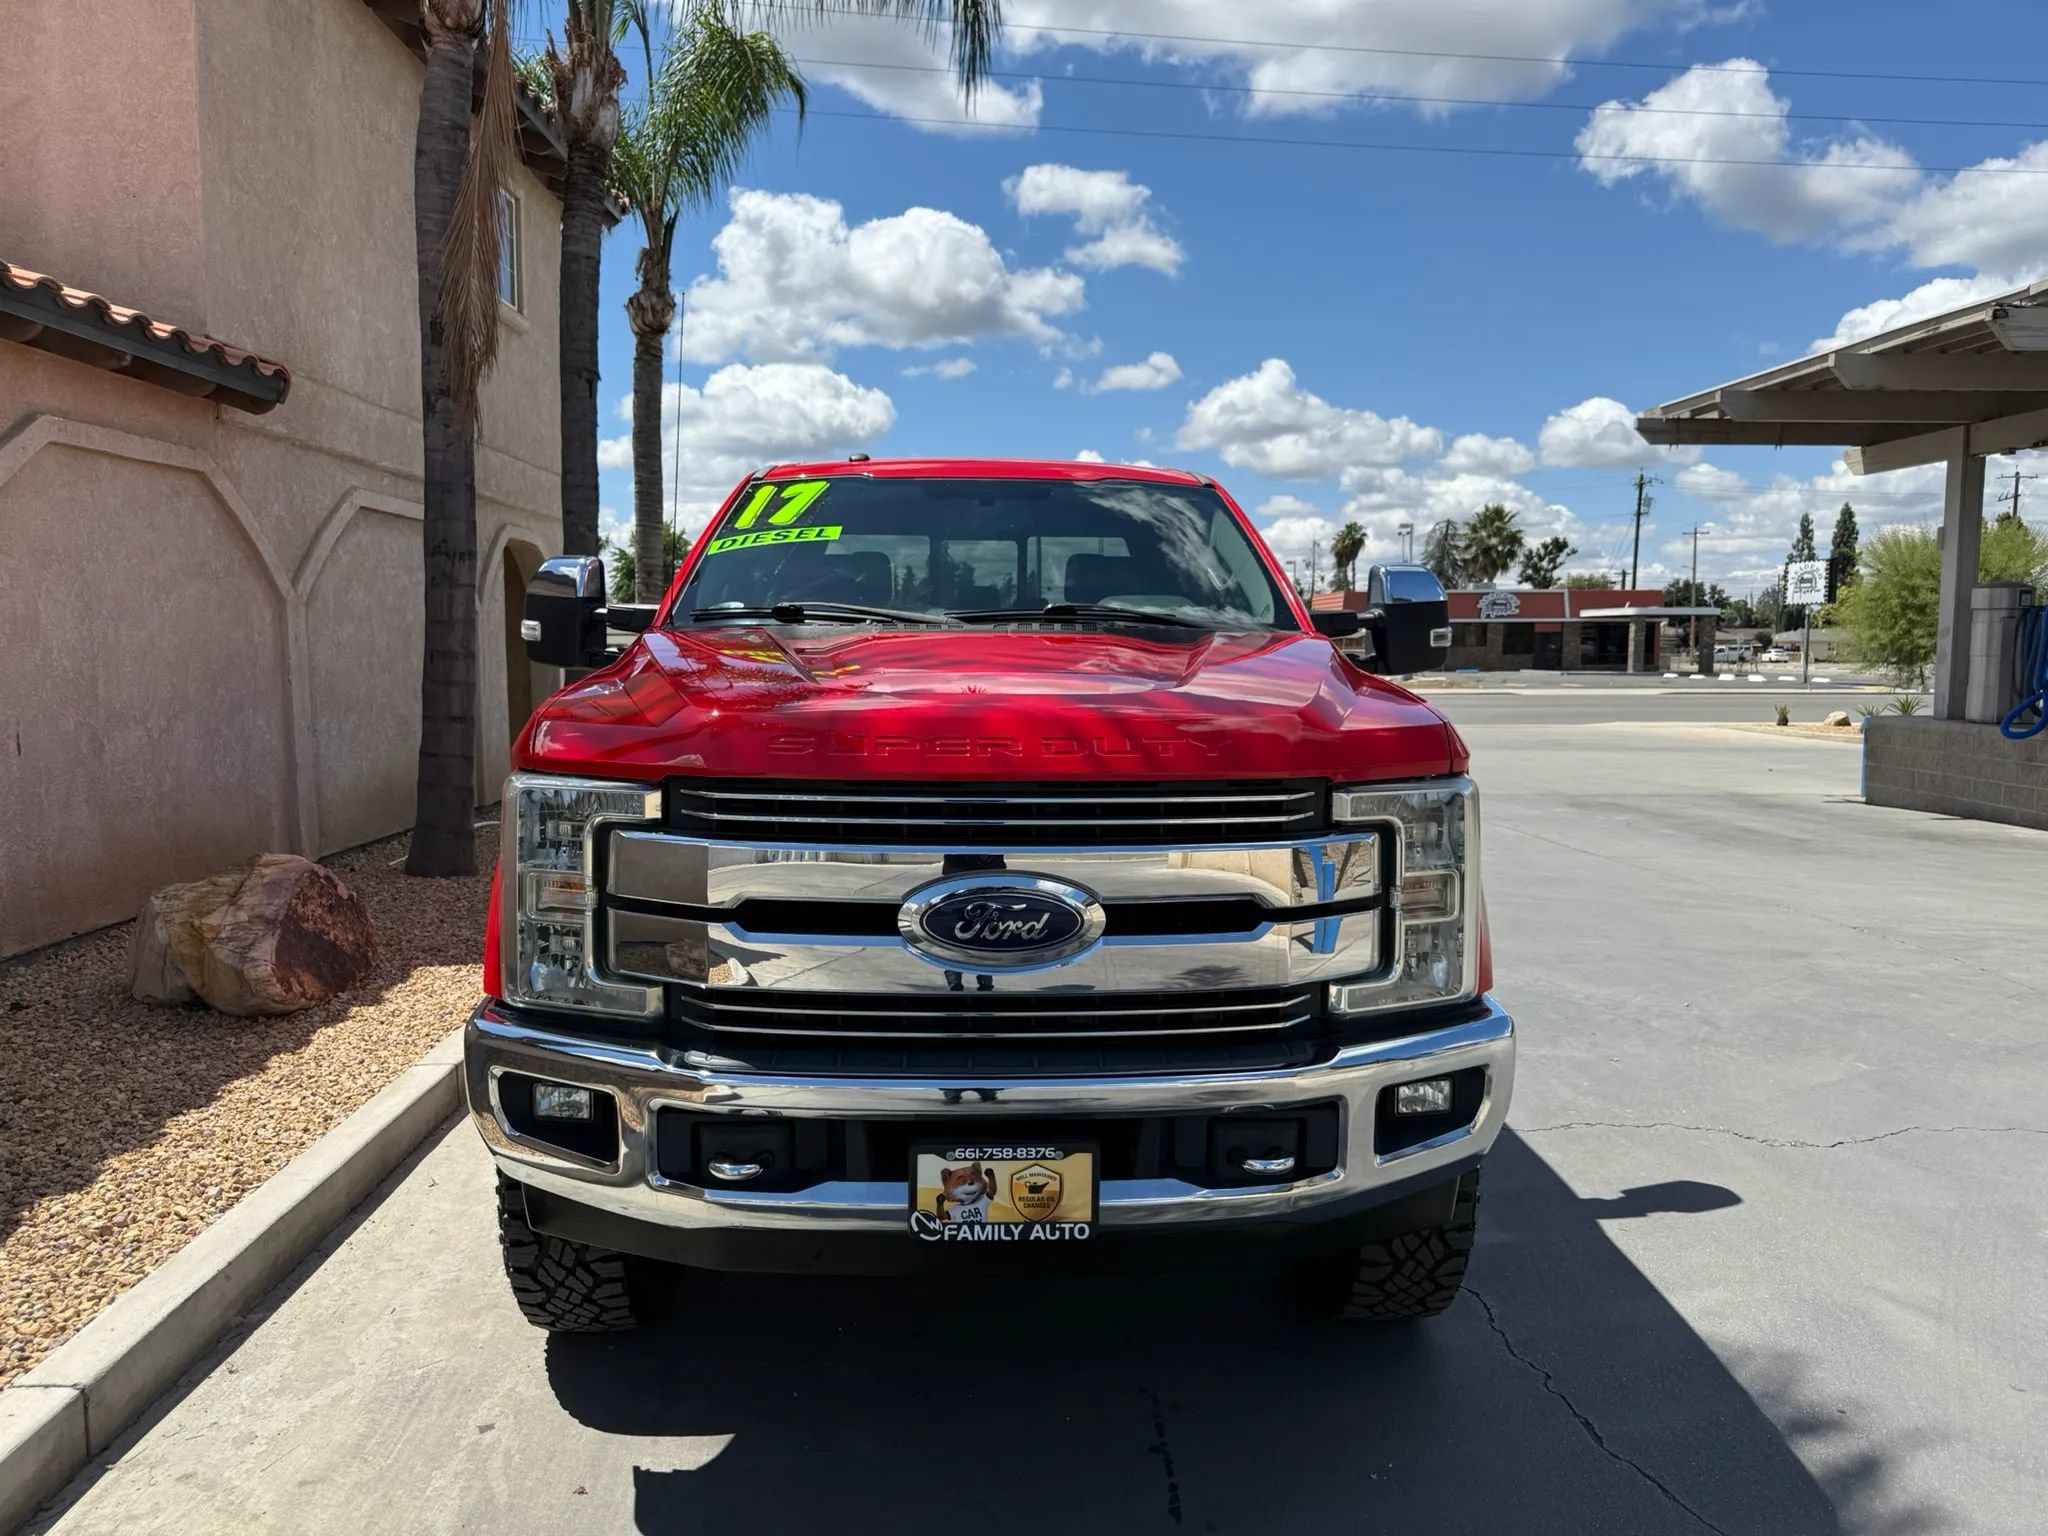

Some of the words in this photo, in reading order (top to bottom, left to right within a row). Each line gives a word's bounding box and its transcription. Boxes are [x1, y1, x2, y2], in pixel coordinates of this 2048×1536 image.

[734, 480, 830, 530] 17
[716, 526, 831, 552] DIESEL
[767, 734, 1022, 758] SUPER
[1040, 735, 1231, 758] DUTY
[954, 901, 1051, 941] Ford
[954, 1147, 1056, 1160] 661-758-8376
[960, 1206, 982, 1219] CAR
[944, 1223, 1025, 1241] FAMILY
[1029, 1223, 1090, 1240] AUTO
